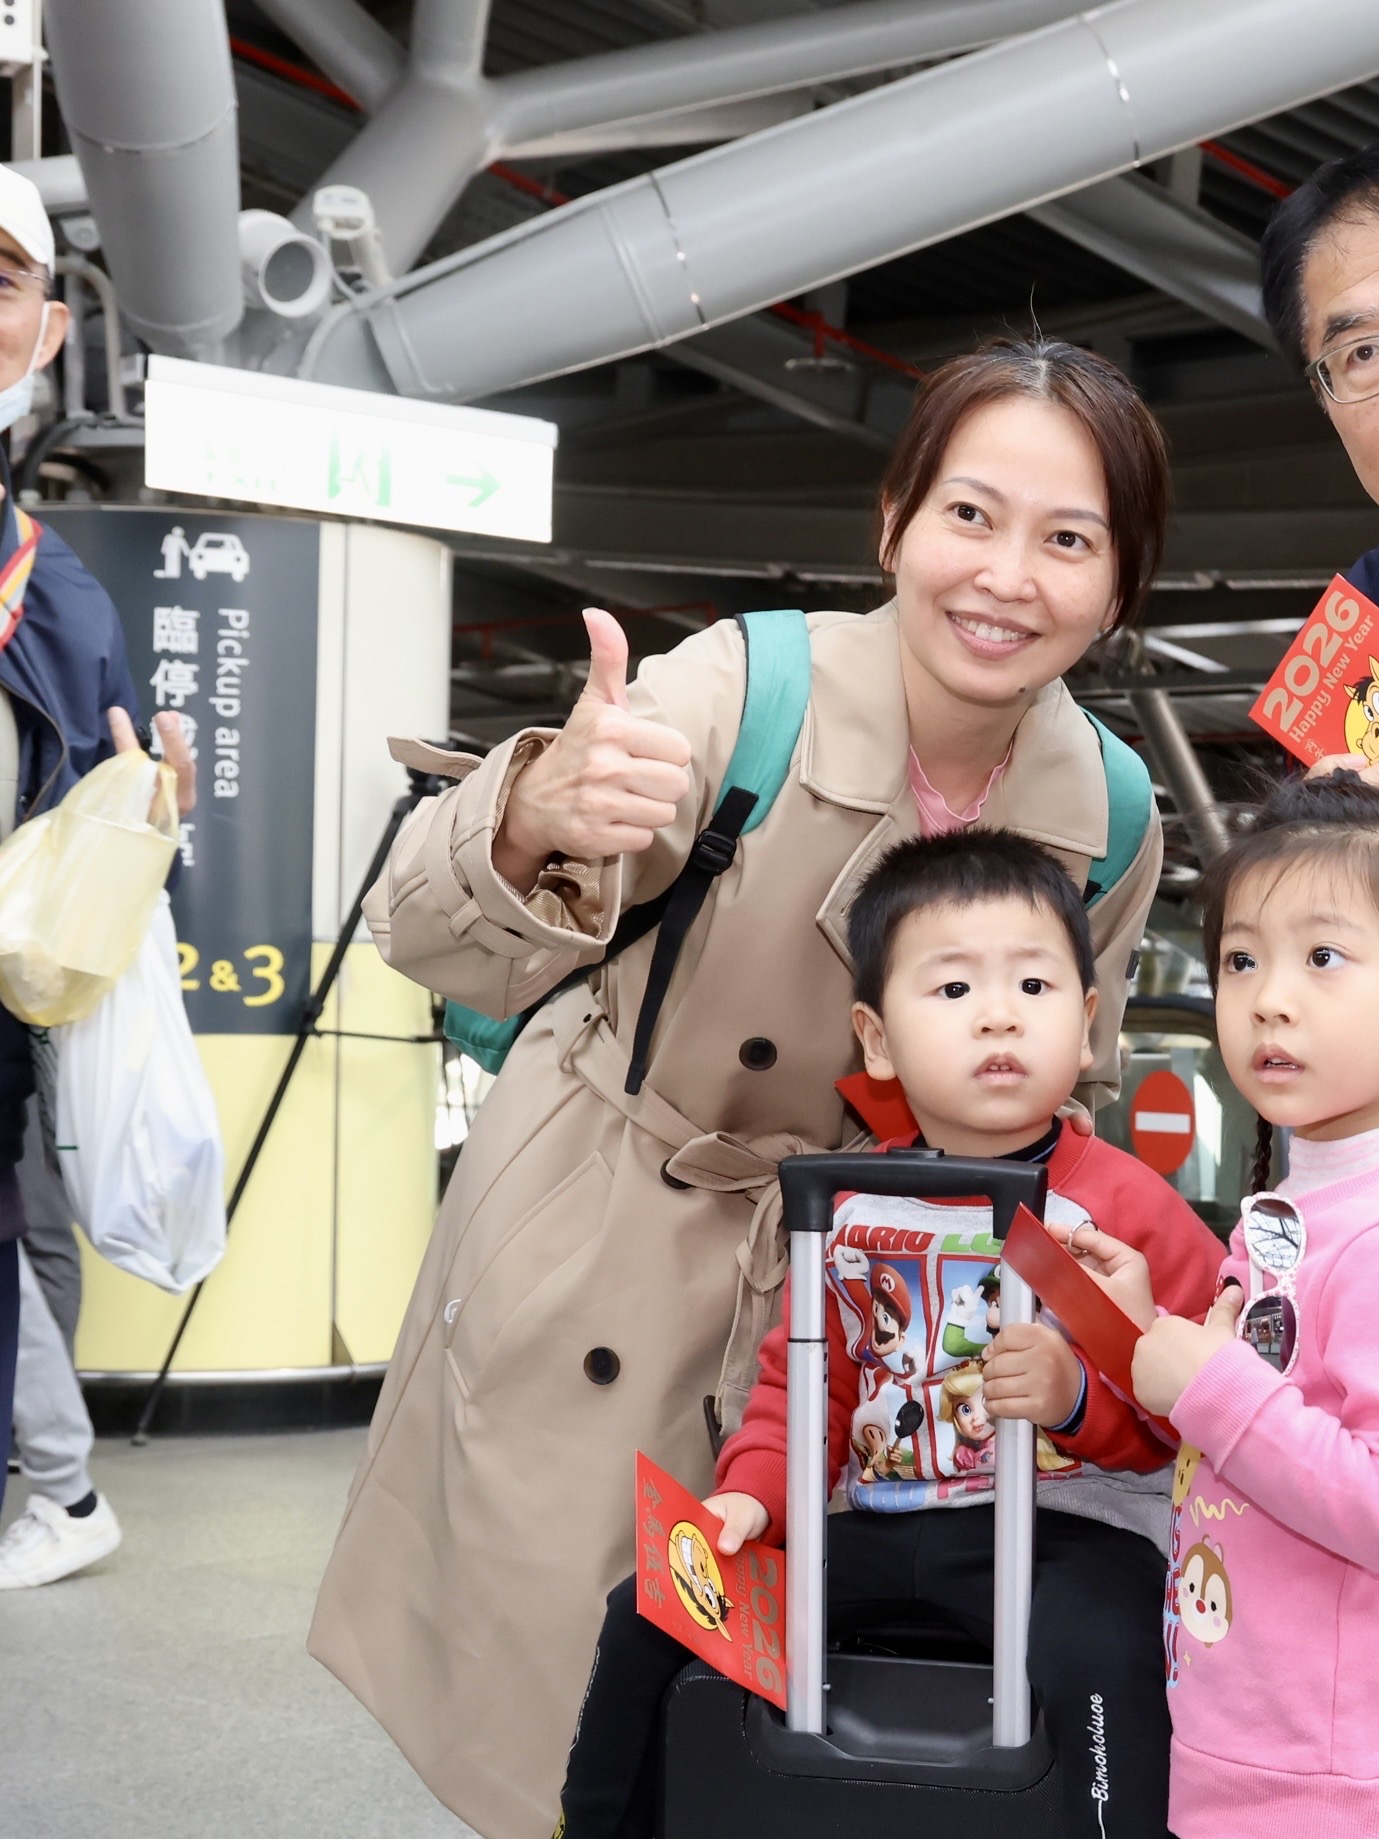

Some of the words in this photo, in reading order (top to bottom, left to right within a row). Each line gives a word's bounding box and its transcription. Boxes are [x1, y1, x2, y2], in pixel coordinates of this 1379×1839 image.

[208, 608, 250, 718] Pickup
[1263, 590, 1360, 734] 2026
[1288, 690, 1332, 744] Happy
[1322, 653, 1351, 690] New
[1344, 614, 1375, 652] Year
[214, 726, 240, 798] area
[734, 1550, 748, 1597] appy
[738, 1601, 751, 1638] New
[742, 1642, 754, 1680] Year
[750, 1551, 783, 1696] 2026
